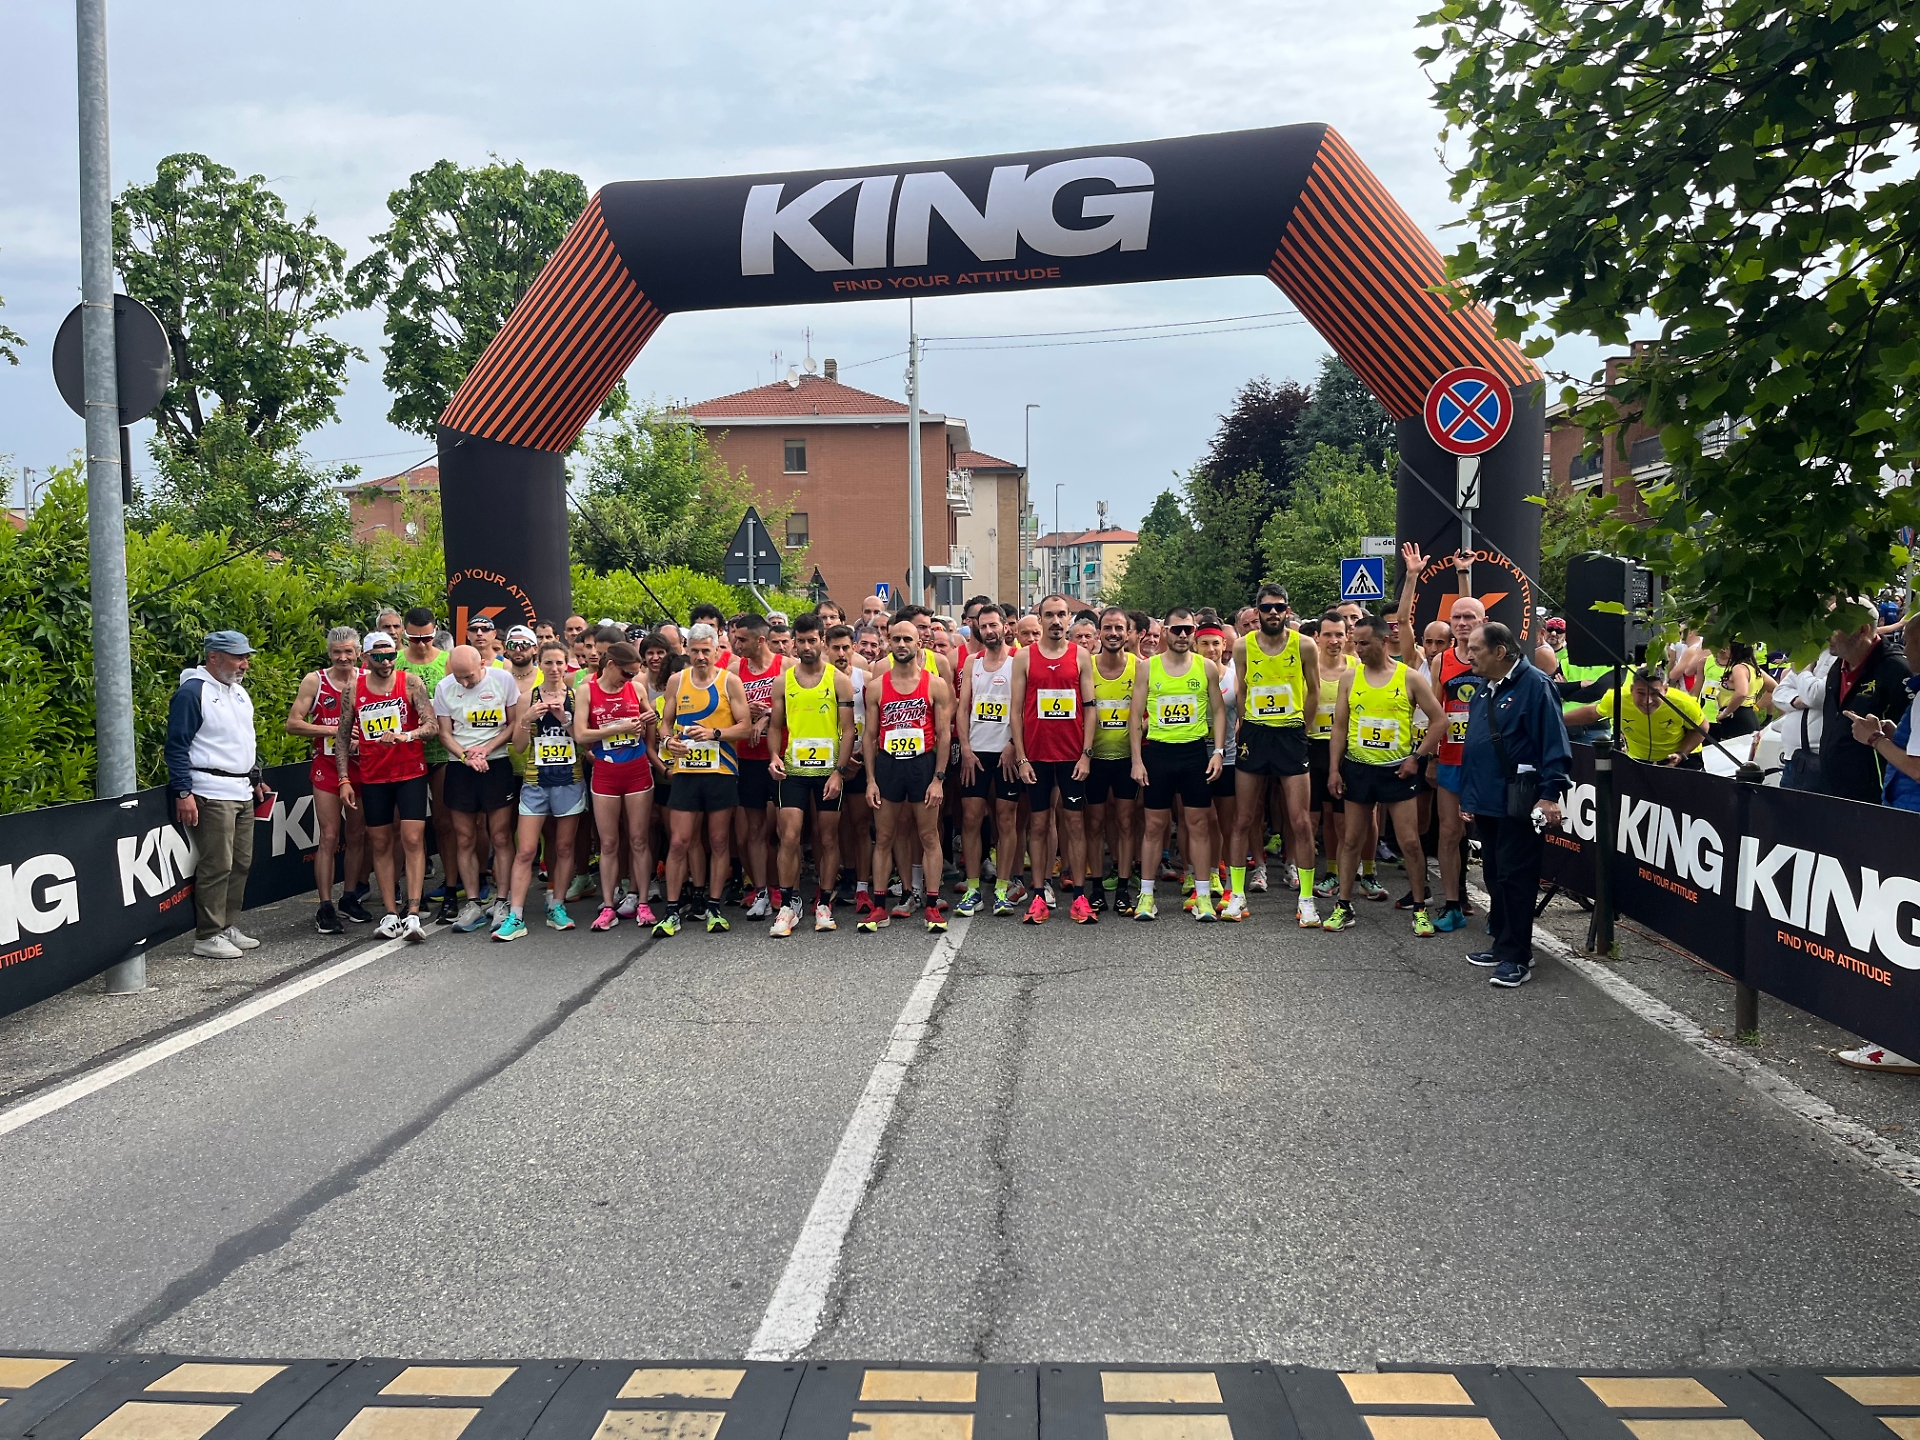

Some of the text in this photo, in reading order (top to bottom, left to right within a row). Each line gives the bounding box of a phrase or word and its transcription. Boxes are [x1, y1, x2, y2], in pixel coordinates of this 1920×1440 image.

[741, 156, 1155, 276] KING
[832, 267, 1061, 292] FIND YOUR ATTITUDE
[464, 569, 507, 586] YOUR
[1420, 550, 1531, 641] FIND OUR ATTITUDE
[1186, 681, 1200, 689] TRR
[884, 698, 925, 712] ATLETICA
[1053, 699, 1061, 711] 6
[1266, 695, 1275, 707] 3
[471, 710, 498, 722] 144
[980, 703, 1003, 716] 139
[1110, 709, 1119, 721] 4
[1164, 704, 1190, 717] 643
[367, 716, 392, 732] 617
[1372, 728, 1381, 740] 5
[542, 745, 567, 757] 537
[891, 738, 916, 751] 596
[686, 749, 710, 761] 331
[809, 747, 817, 760] 2
[1555, 837, 1581, 853] ATTITUDE
[1616, 794, 1724, 896] KING
[1638, 867, 1698, 904] FIND YOUR ATTITUDE
[1735, 835, 1920, 970] KING
[1777, 930, 1892, 987] FIND YOUR ATTITUDE
